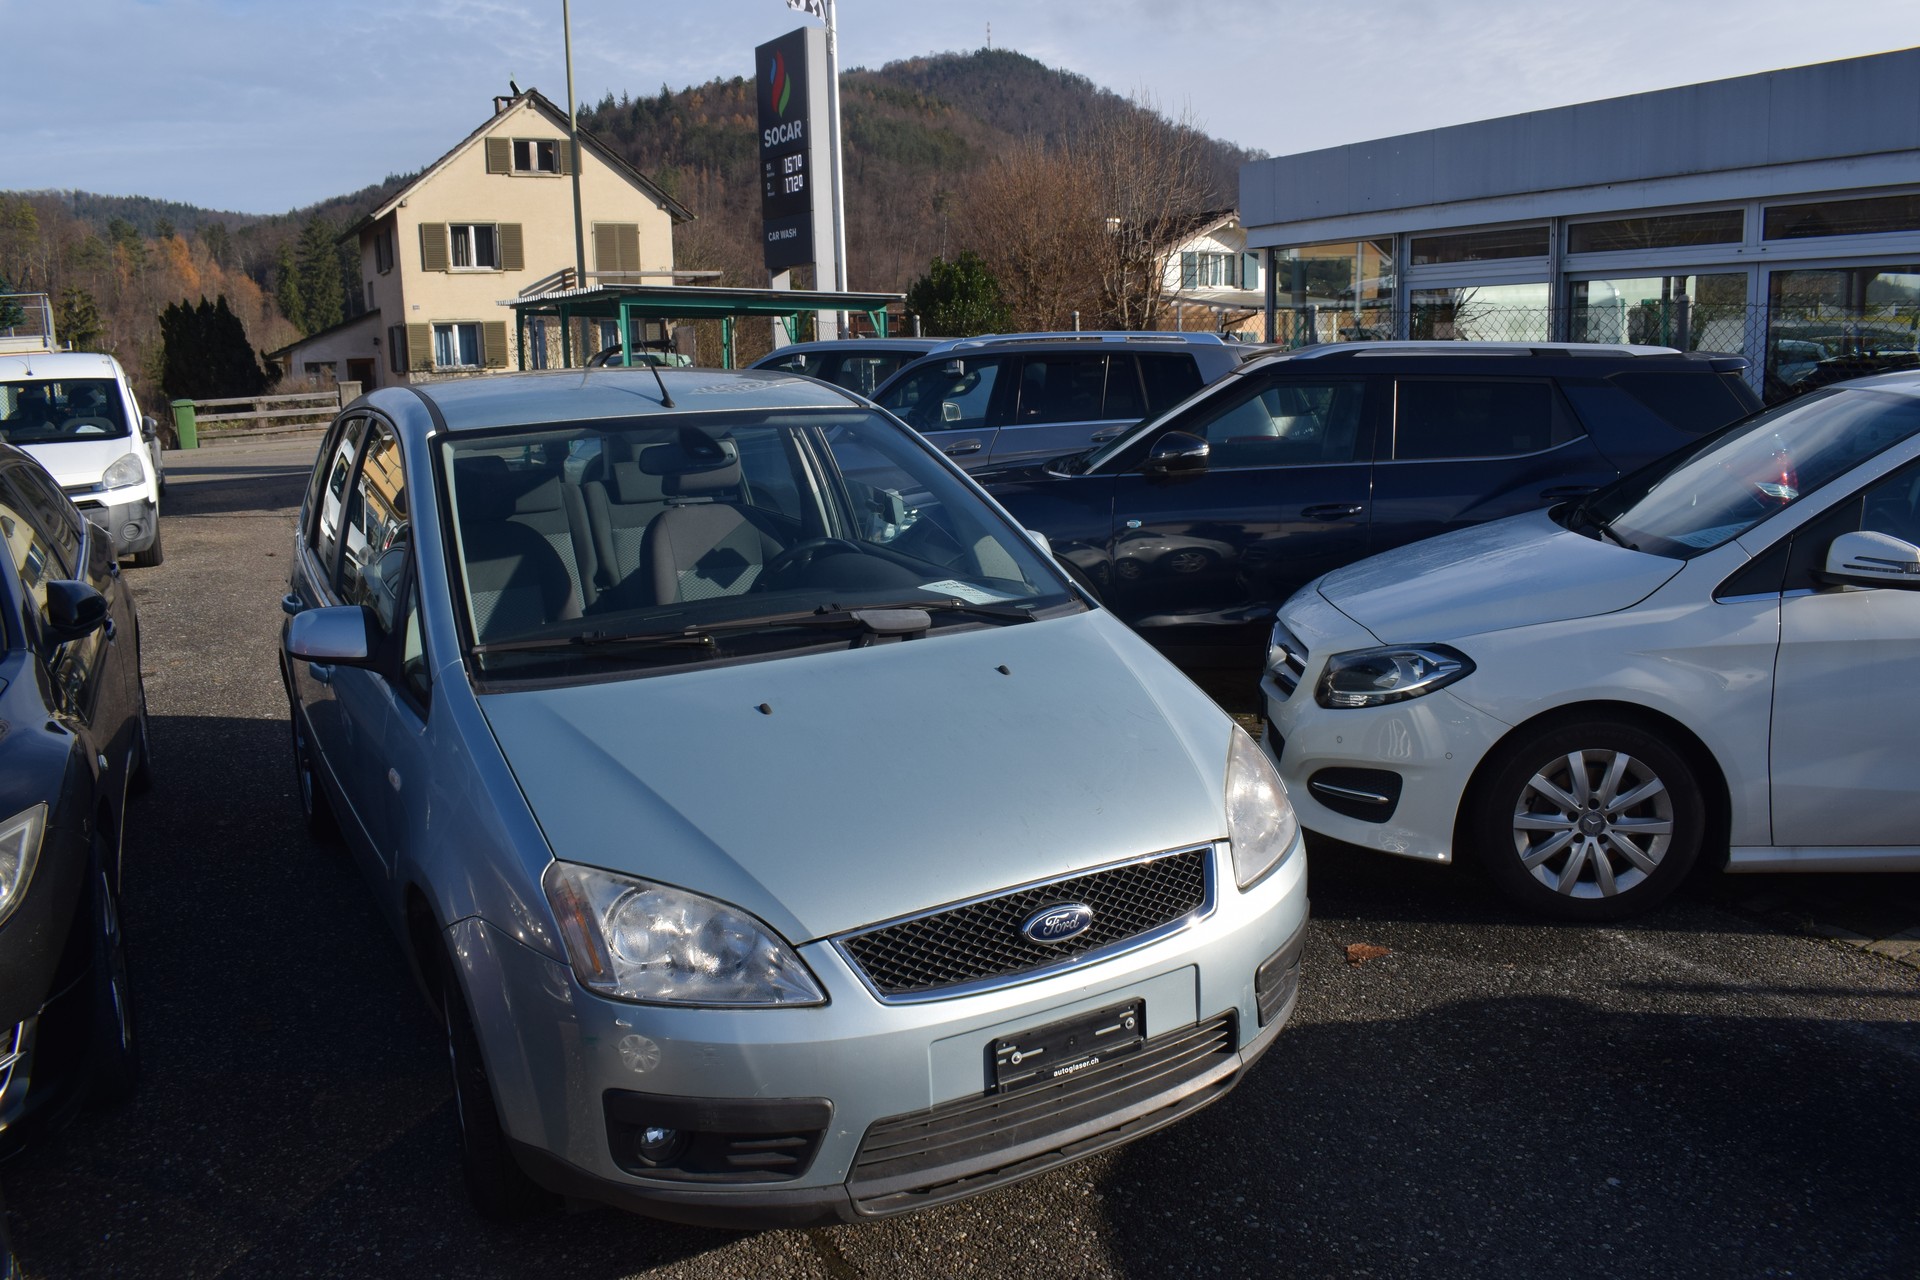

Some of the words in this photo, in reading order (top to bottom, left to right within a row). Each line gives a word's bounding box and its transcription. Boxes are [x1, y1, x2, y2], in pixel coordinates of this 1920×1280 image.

[764, 120, 802, 148] SOCAR
[768, 231, 780, 242] CAR
[780, 228, 797, 240] WASH
[1043, 912, 1080, 936] Ford
[1053, 1057, 1100, 1077] autoglaser.ch
